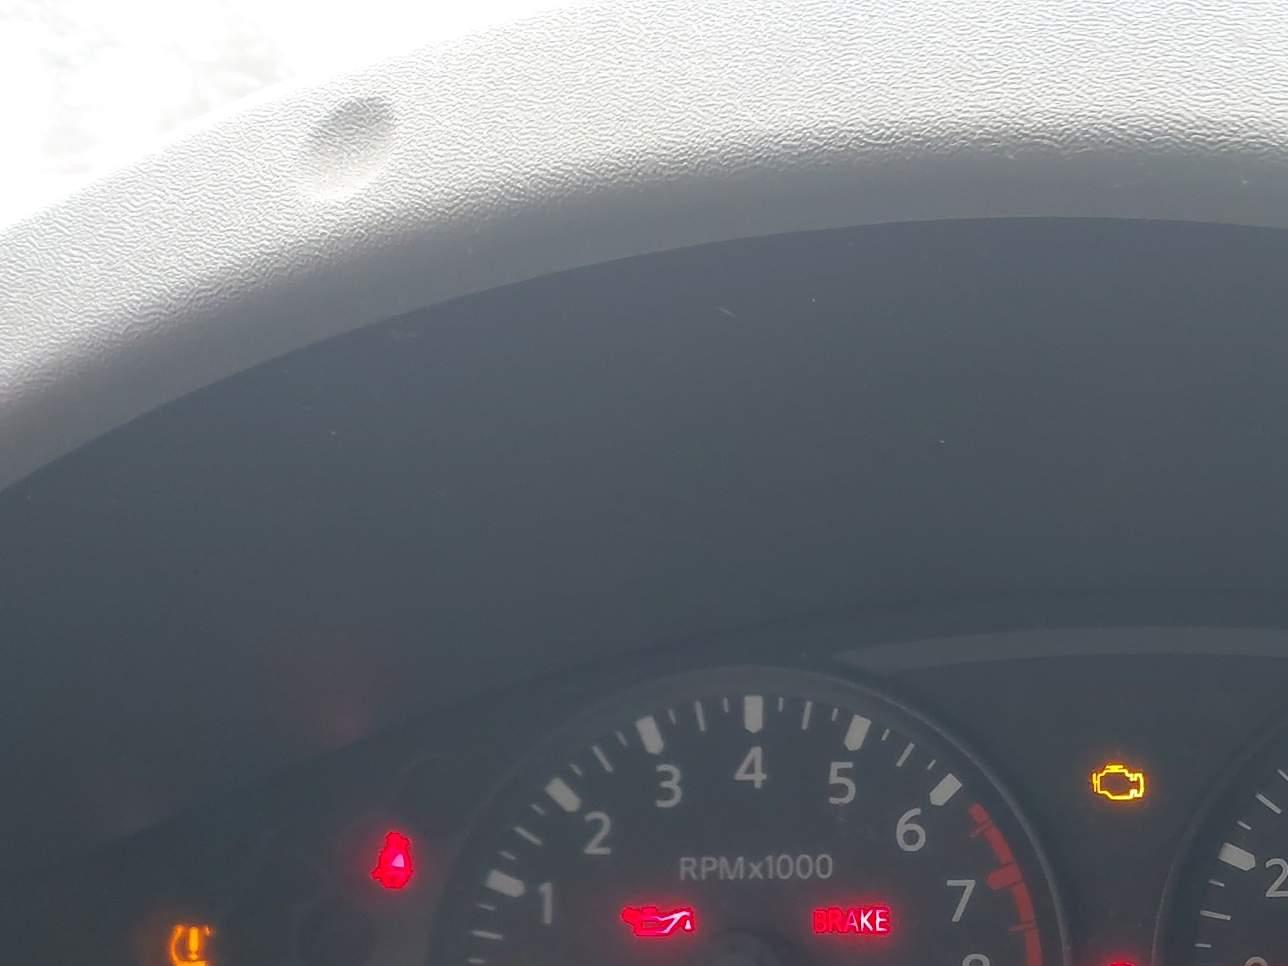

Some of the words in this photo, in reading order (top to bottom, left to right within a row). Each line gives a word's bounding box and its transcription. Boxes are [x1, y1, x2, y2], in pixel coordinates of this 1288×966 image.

[655, 764, 683, 808] 3
[734, 746, 767, 789] 4
[829, 762, 857, 805] 5
[583, 812, 611, 855] 2
[895, 808, 926, 852] 6
[680, 853, 833, 880] RPMx1000
[538, 882, 553, 925] 1
[813, 908, 888, 933] BRAKE
[946, 879, 976, 923] 7
